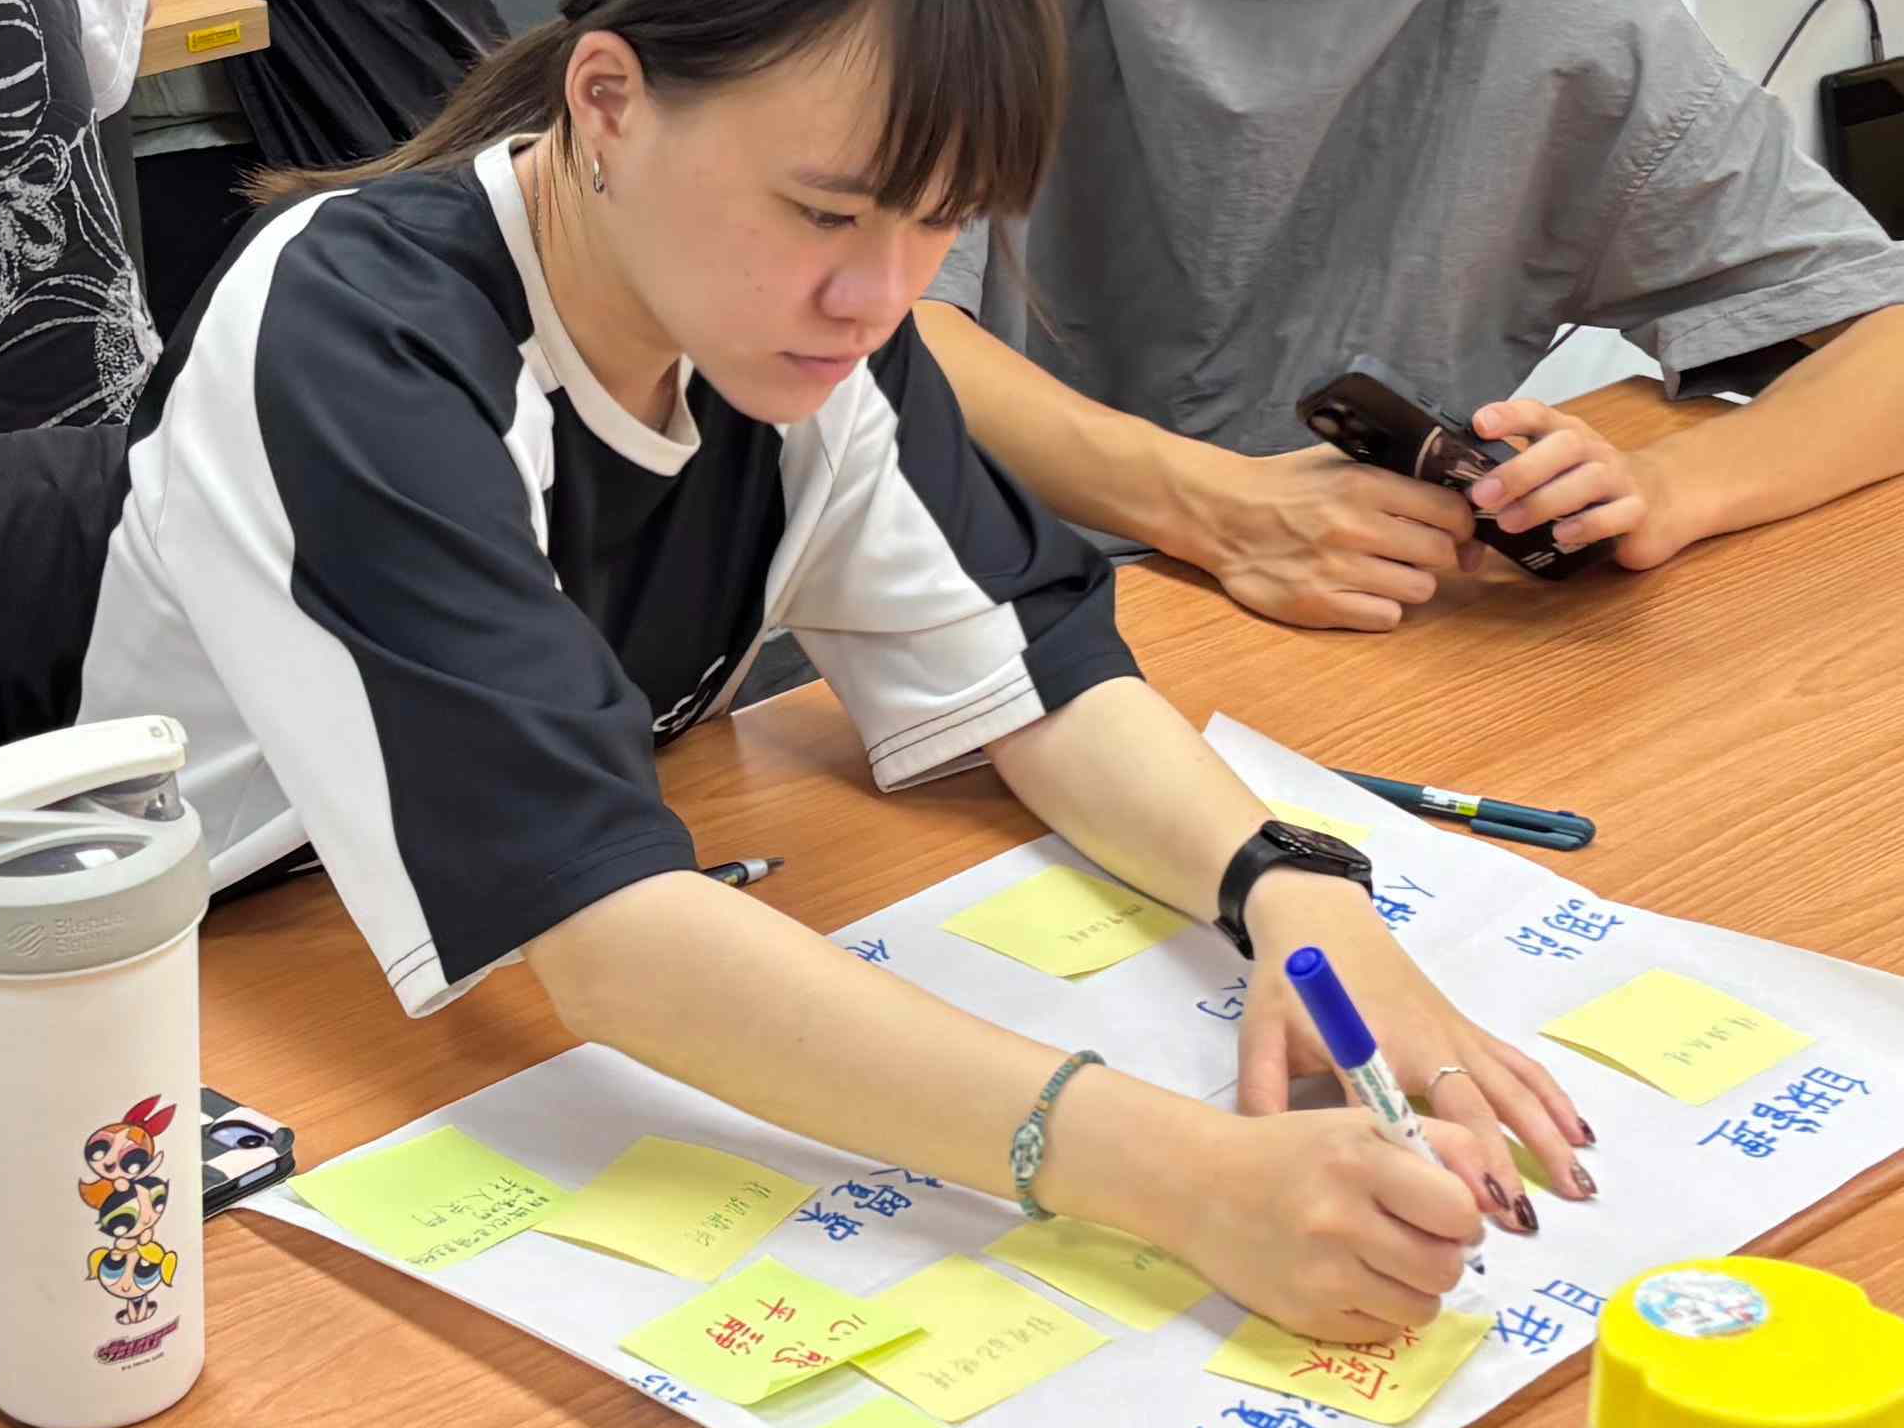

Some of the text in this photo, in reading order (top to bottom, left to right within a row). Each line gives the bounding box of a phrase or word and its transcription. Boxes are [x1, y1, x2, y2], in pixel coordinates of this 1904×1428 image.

[1696, 1066, 1872, 1160] 自我管理
[1492, 1278, 1607, 1355] 自我
